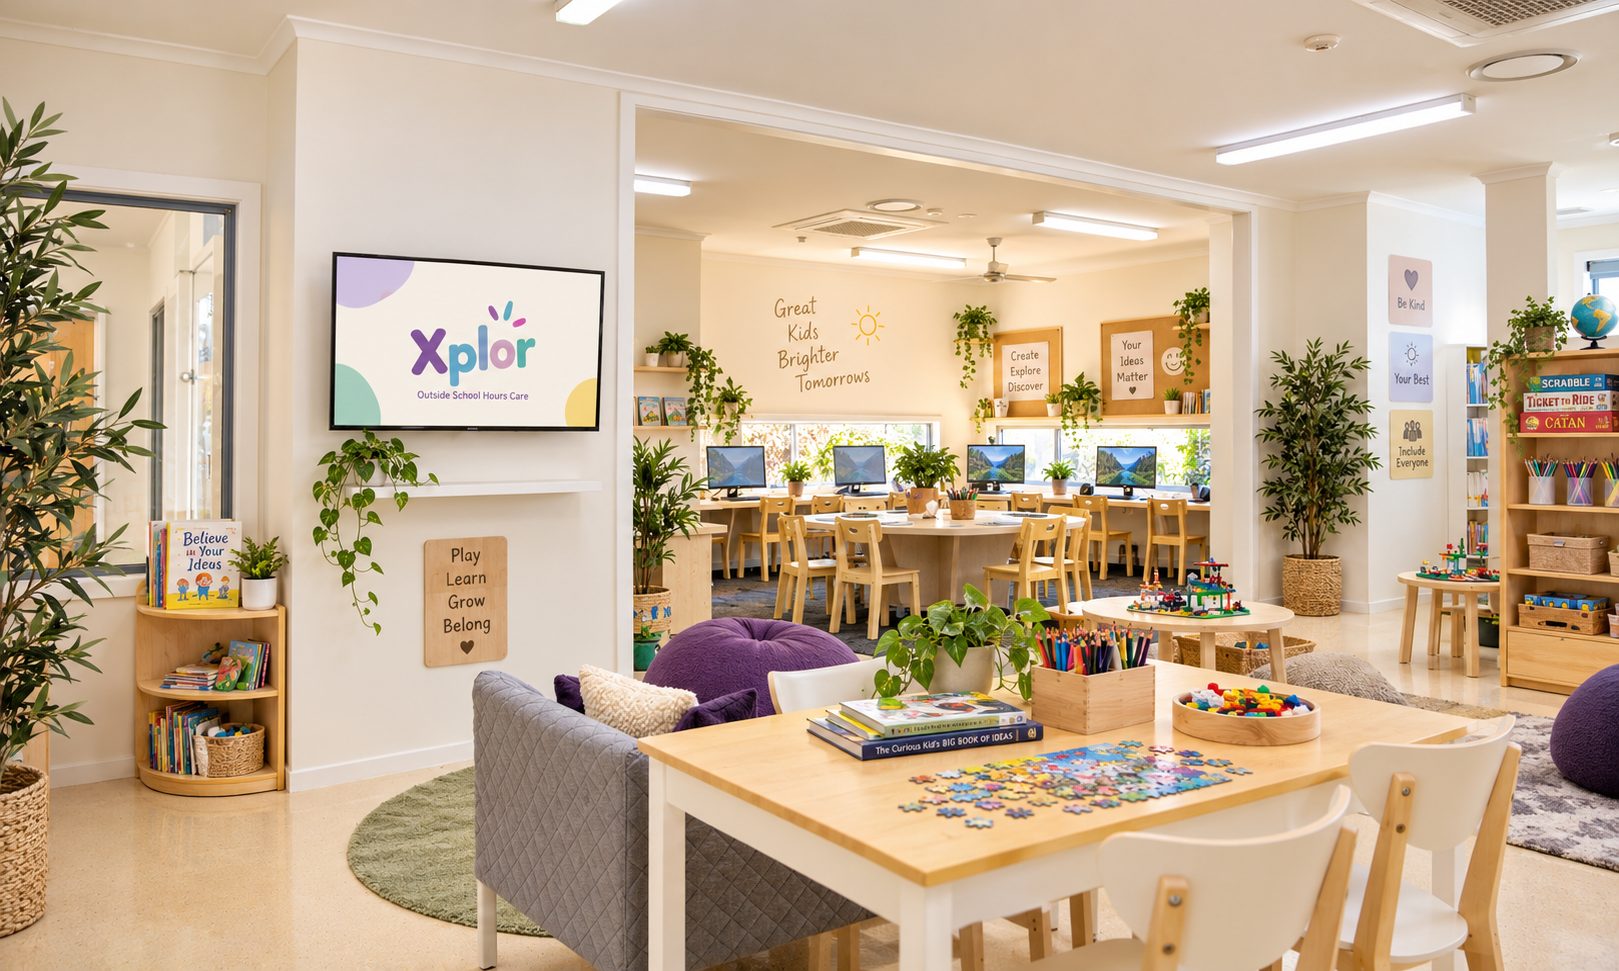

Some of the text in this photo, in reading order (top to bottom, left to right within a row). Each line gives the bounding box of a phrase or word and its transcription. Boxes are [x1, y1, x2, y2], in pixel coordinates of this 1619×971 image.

[774, 296, 816, 318] Great
[1398, 296, 1425, 310] Be Kind
[788, 321, 818, 342] Kids
[1122, 340, 1142, 350] Your
[410, 324, 536, 387] Xplor
[778, 345, 839, 372] Brighter
[1010, 350, 1039, 361] Create
[1120, 356, 1144, 366] Ideas
[1010, 365, 1041, 378] Explore
[1117, 372, 1148, 382] Matter
[795, 370, 870, 392] Tomorrows
[1394, 372, 1430, 385] Your Best
[1008, 382, 1044, 392] Discover
[418, 390, 529, 400] Outside School Hours Care
[1572, 394, 1595, 406] RIDE
[1544, 416, 1586, 428] CATAN
[1398, 446, 1426, 456] Include
[1396, 458, 1429, 470] Everyone
[184, 531, 229, 546] Believe
[199, 546, 224, 557] Your
[451, 547, 480, 566] Play
[188, 558, 222, 572] Ideas
[446, 572, 486, 586] Learn
[448, 594, 486, 610] Grow
[443, 616, 491, 634] Belong
[876, 731, 1014, 754] The Curious Kid's BIG BOOK OF IDEAS
